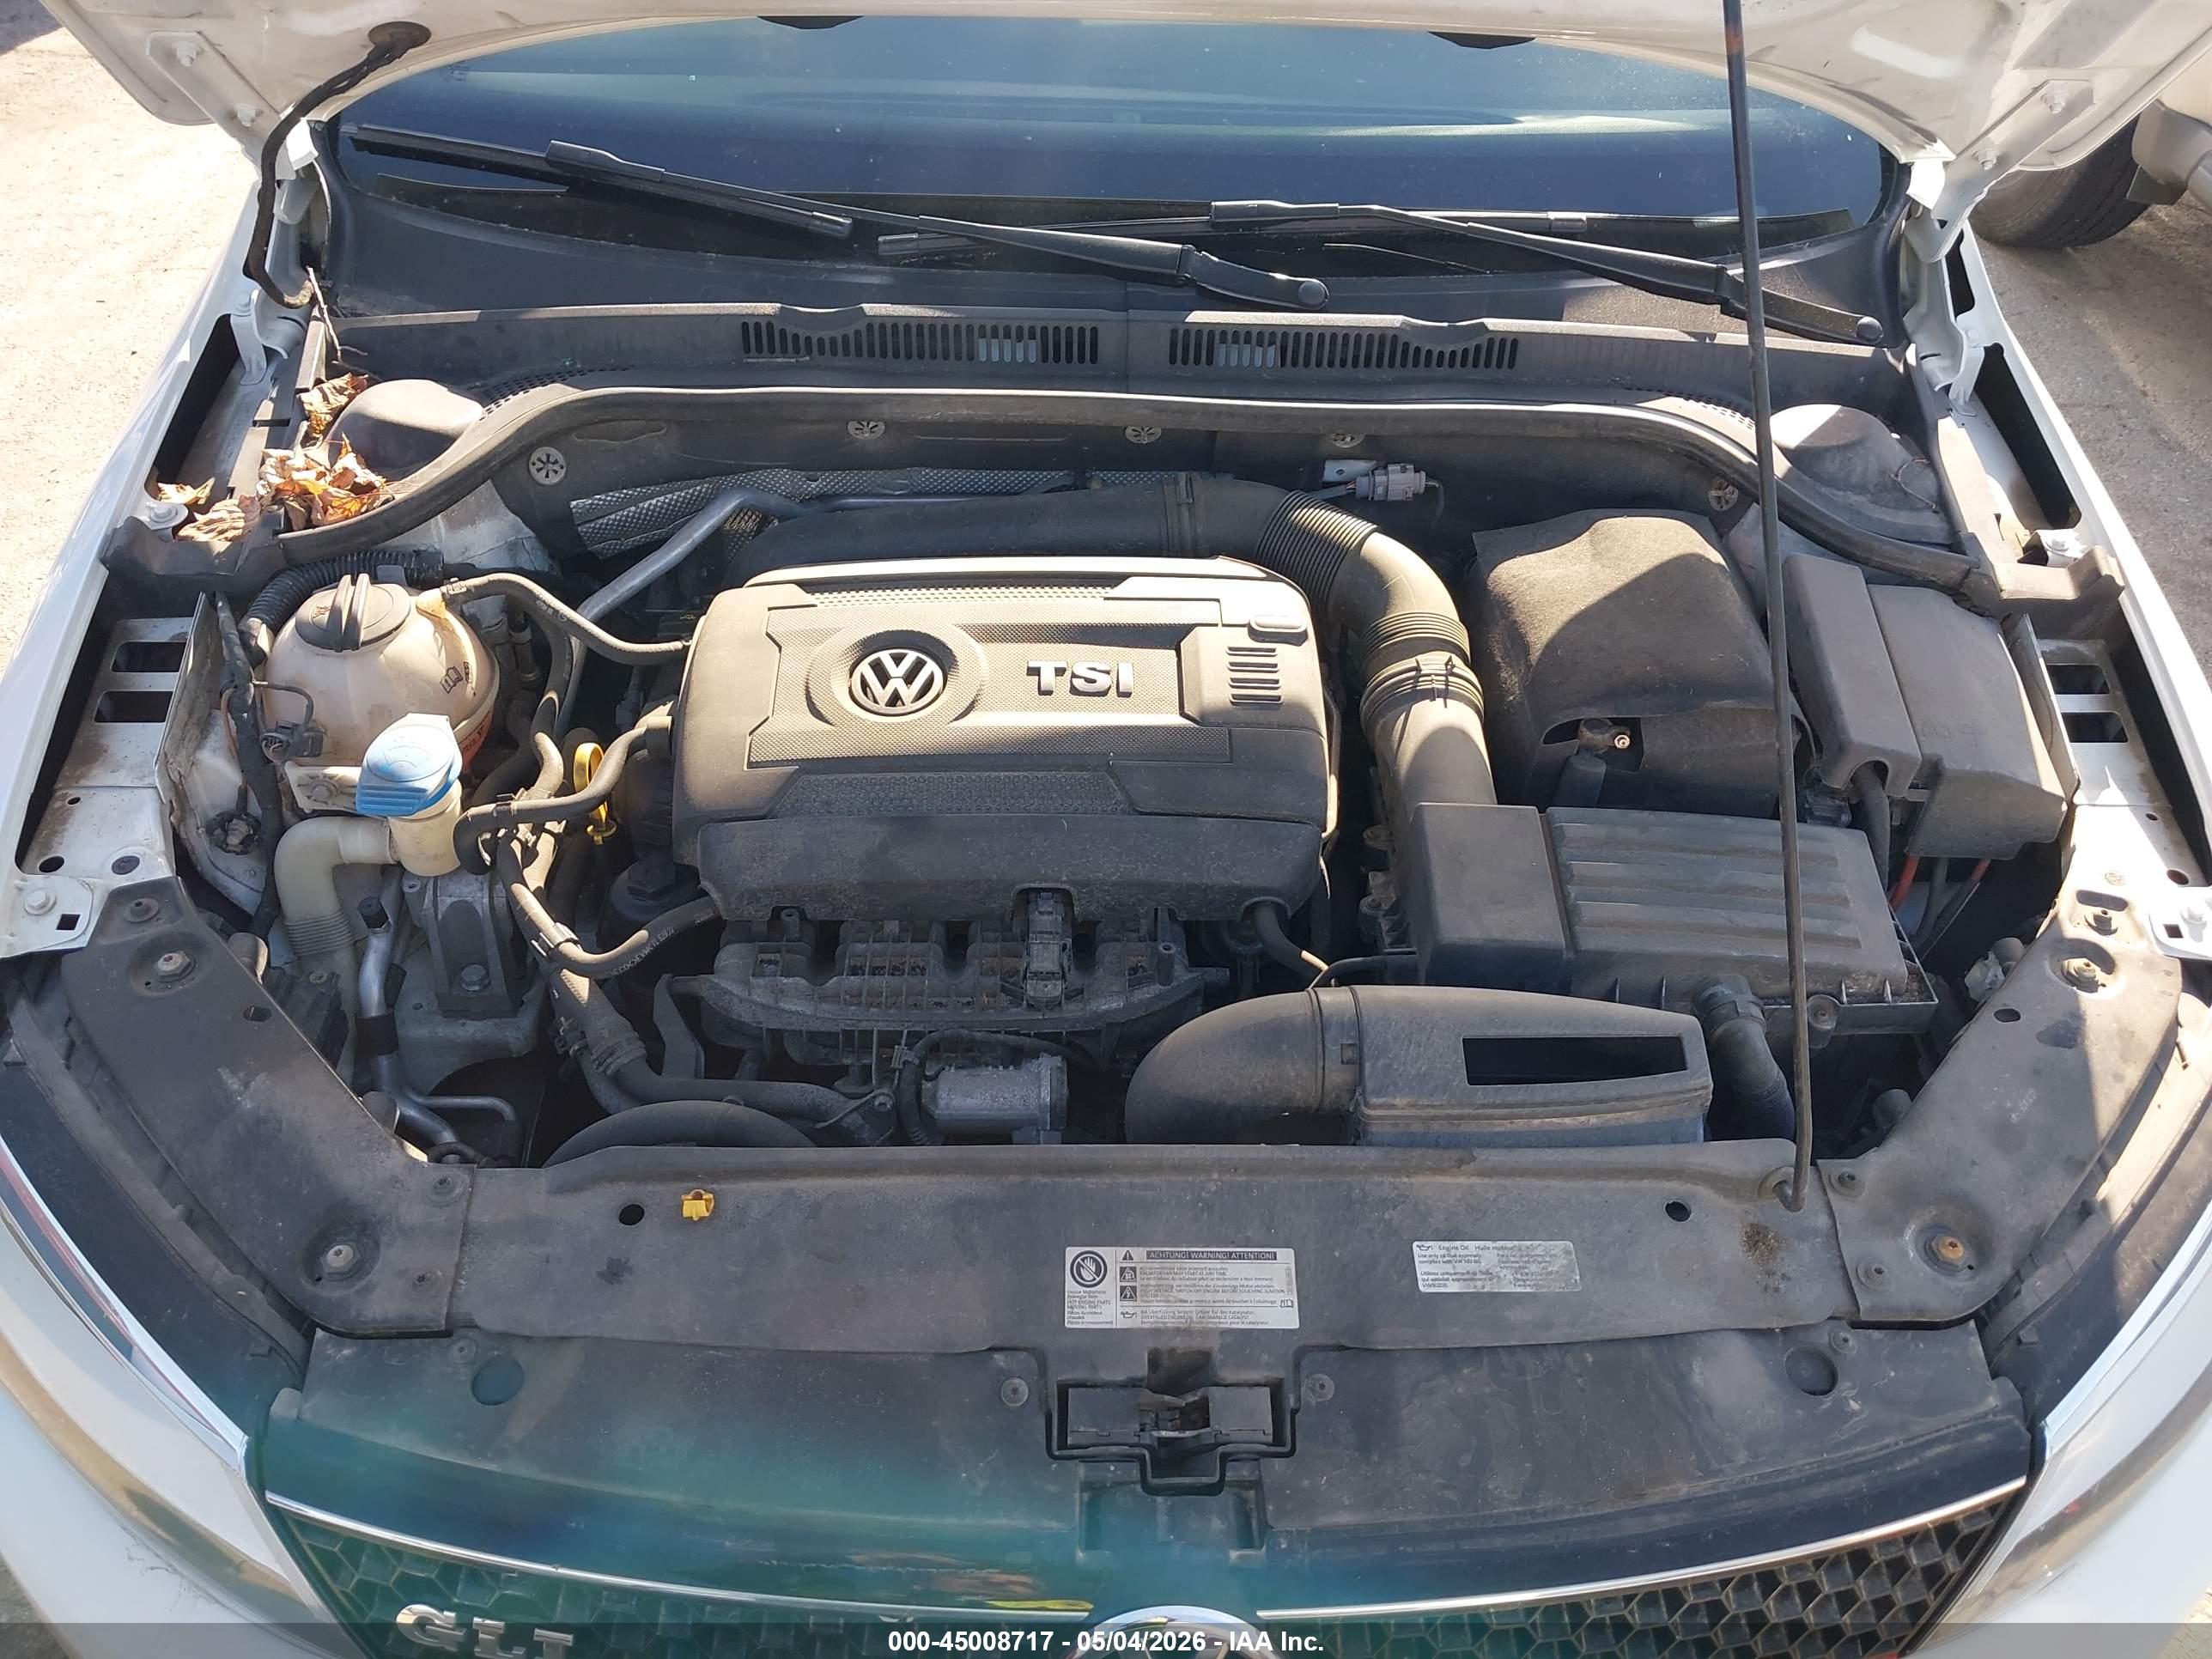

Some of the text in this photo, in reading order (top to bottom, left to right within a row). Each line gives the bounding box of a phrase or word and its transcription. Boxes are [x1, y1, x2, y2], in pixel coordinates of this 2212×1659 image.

[1026, 660, 1134, 697] TSI
[1150, 1250, 1274, 1260] ACHTUNG! WARNING! ATTENTION!
[396, 1604, 574, 1659] GLI
